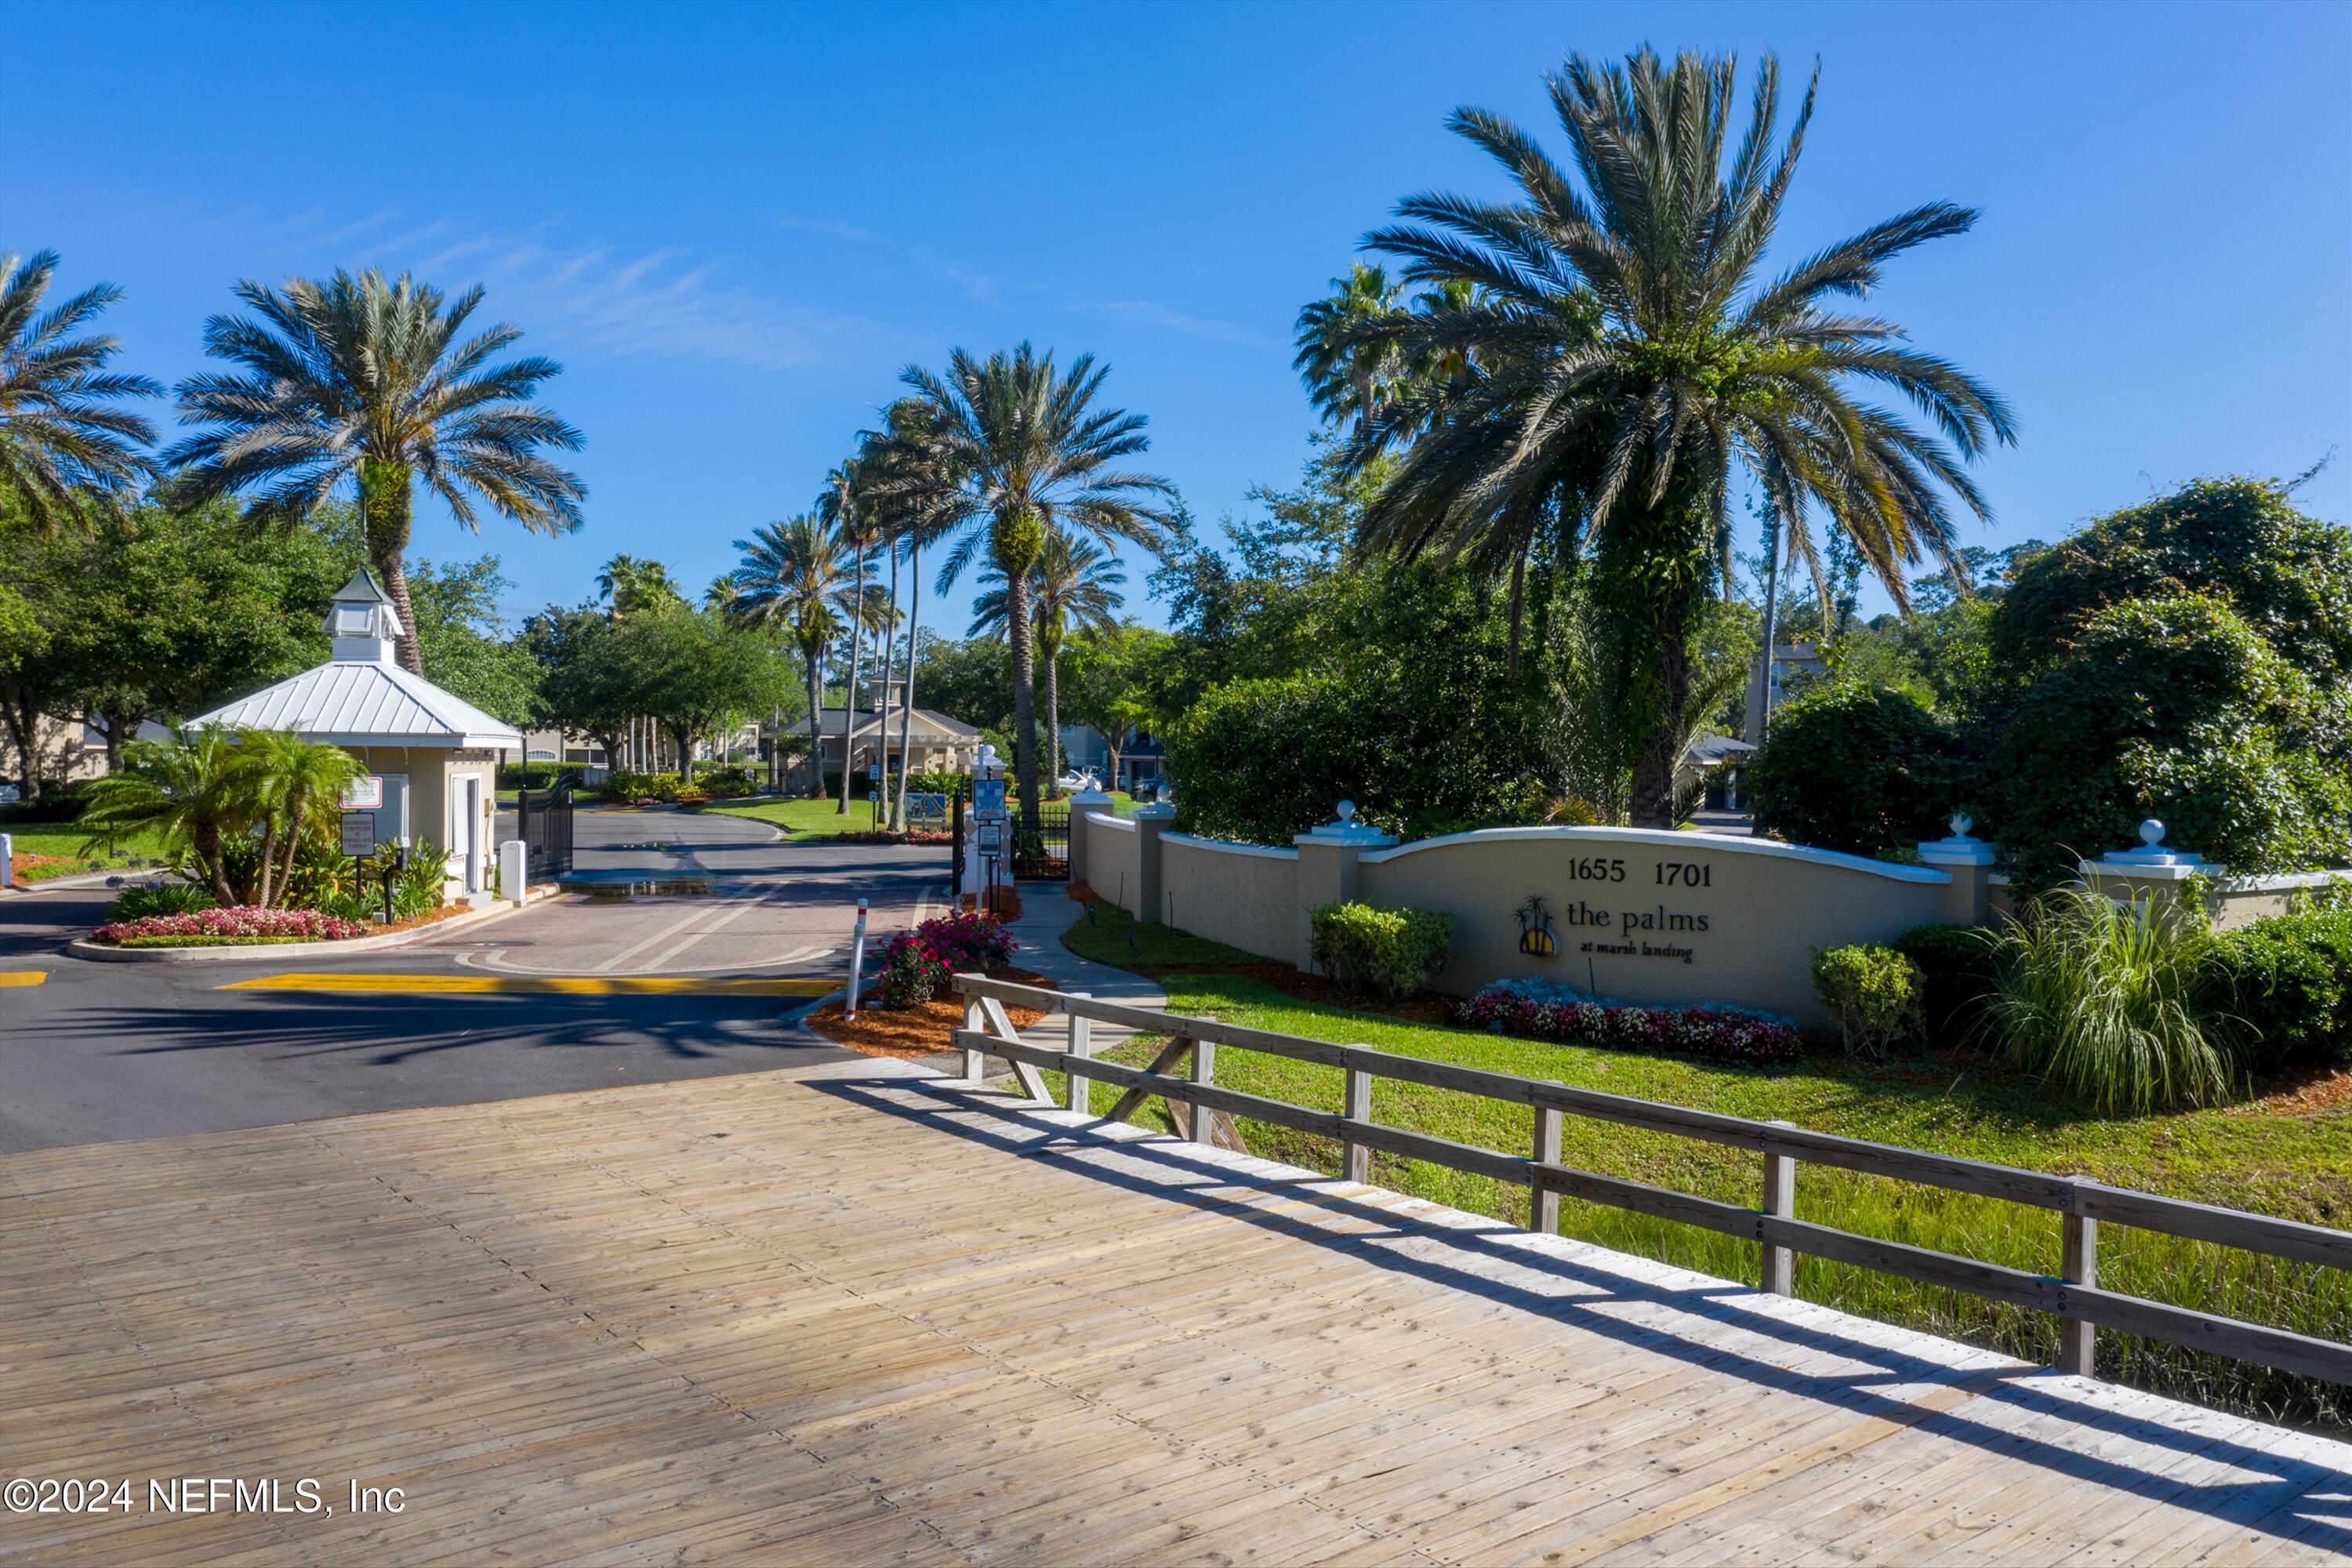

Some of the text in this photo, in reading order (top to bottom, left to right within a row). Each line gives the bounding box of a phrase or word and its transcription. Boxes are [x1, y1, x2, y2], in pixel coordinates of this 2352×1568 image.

[1569, 857, 1711, 887] 1655 1701
[1567, 902, 1709, 938] the palms
[1581, 941, 1693, 964] at marsh landing
